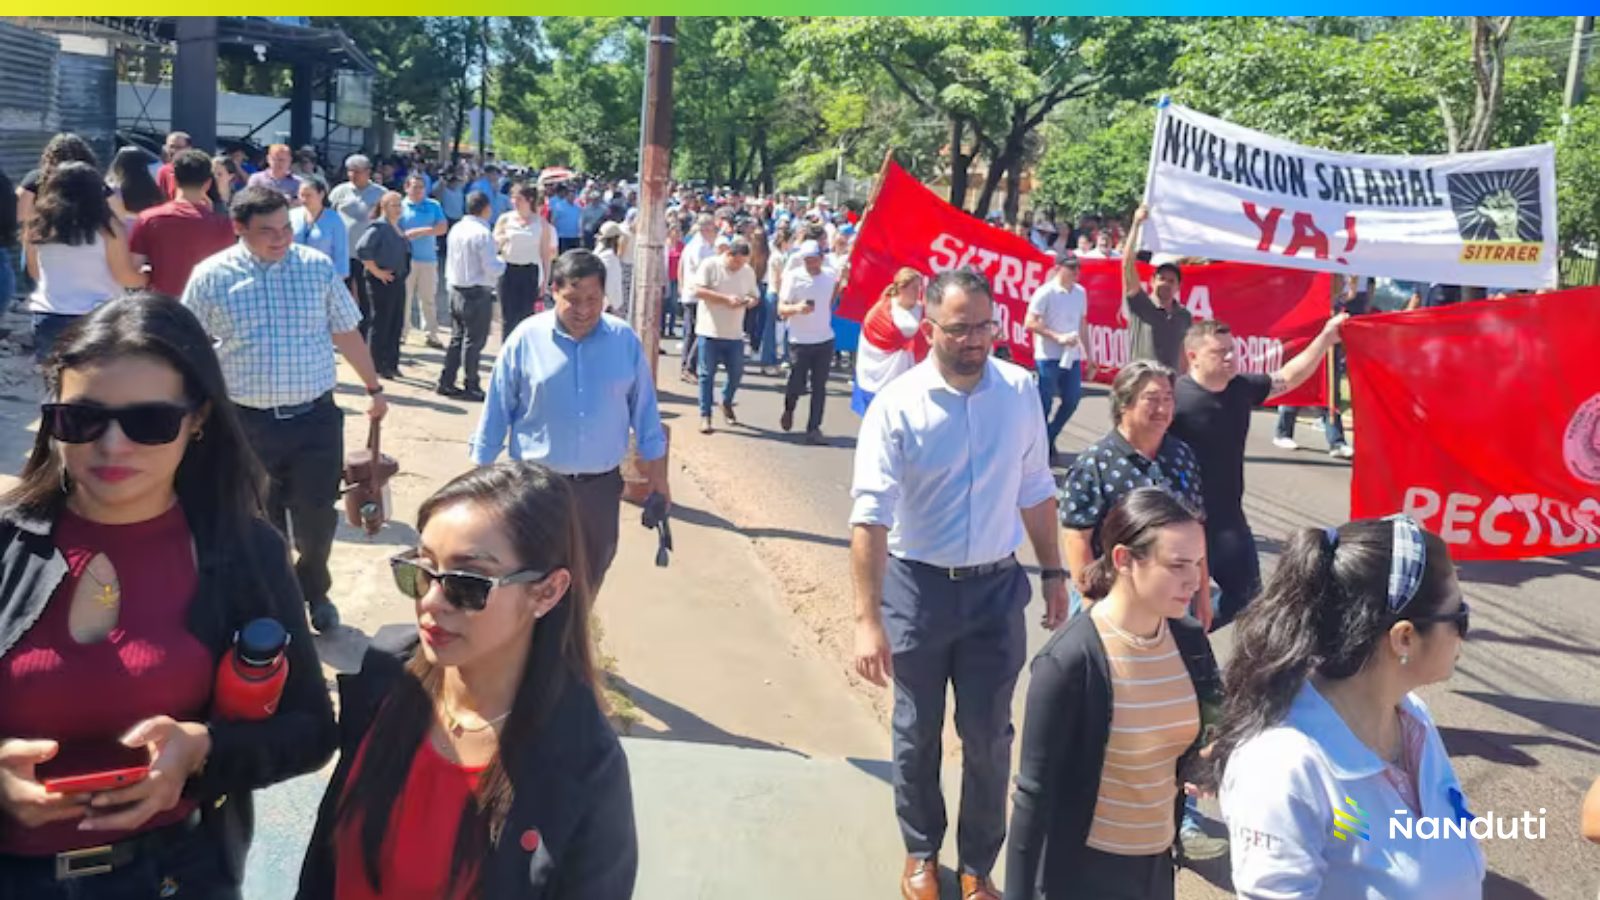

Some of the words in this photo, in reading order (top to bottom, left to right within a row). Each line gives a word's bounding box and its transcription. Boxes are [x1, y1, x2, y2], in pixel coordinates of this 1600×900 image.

[1162, 115, 1308, 198] NIVELACION
[1315, 162, 1443, 207] SALARIAL
[1242, 201, 1357, 265] YA!
[1463, 245, 1539, 261] SITRAER
[928, 232, 1058, 303] SITRE
